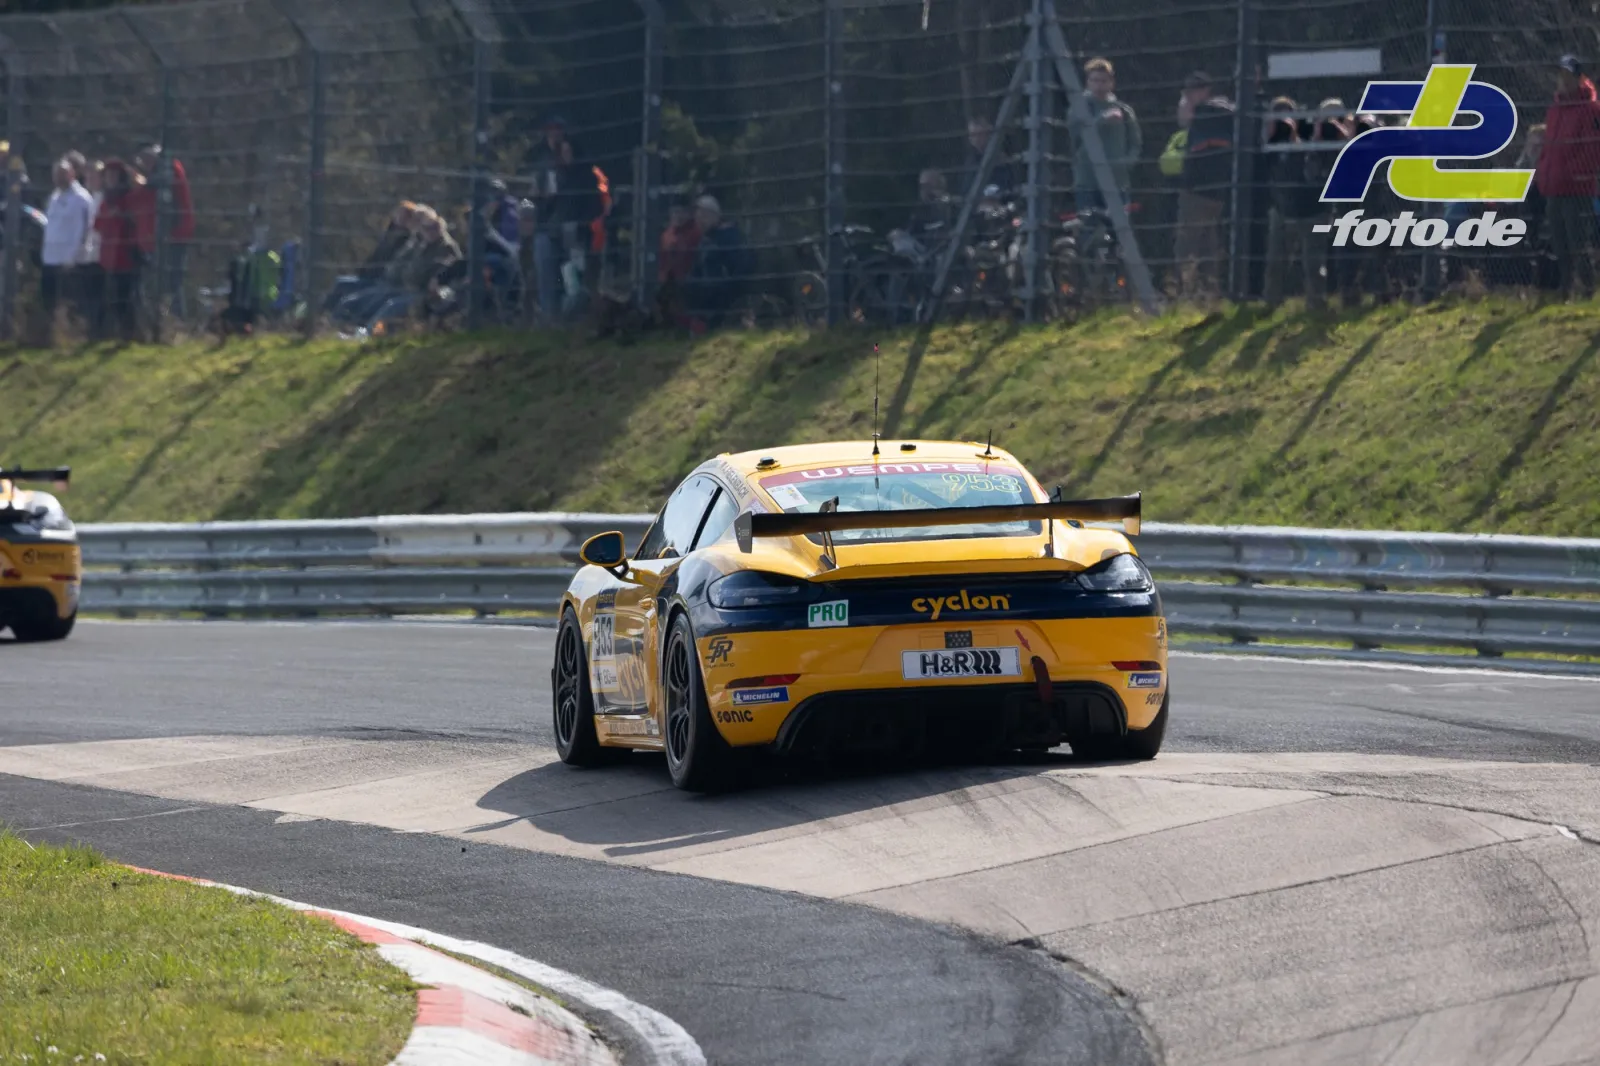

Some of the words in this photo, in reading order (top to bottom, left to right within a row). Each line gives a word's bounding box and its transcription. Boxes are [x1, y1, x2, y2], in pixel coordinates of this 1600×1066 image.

[801, 463, 982, 479] WEMPE
[942, 472, 1022, 494] 953
[809, 602, 847, 623] PRO
[911, 589, 1010, 620] cyclon
[920, 652, 972, 676] H&R
[742, 691, 780, 701] MICHELIN
